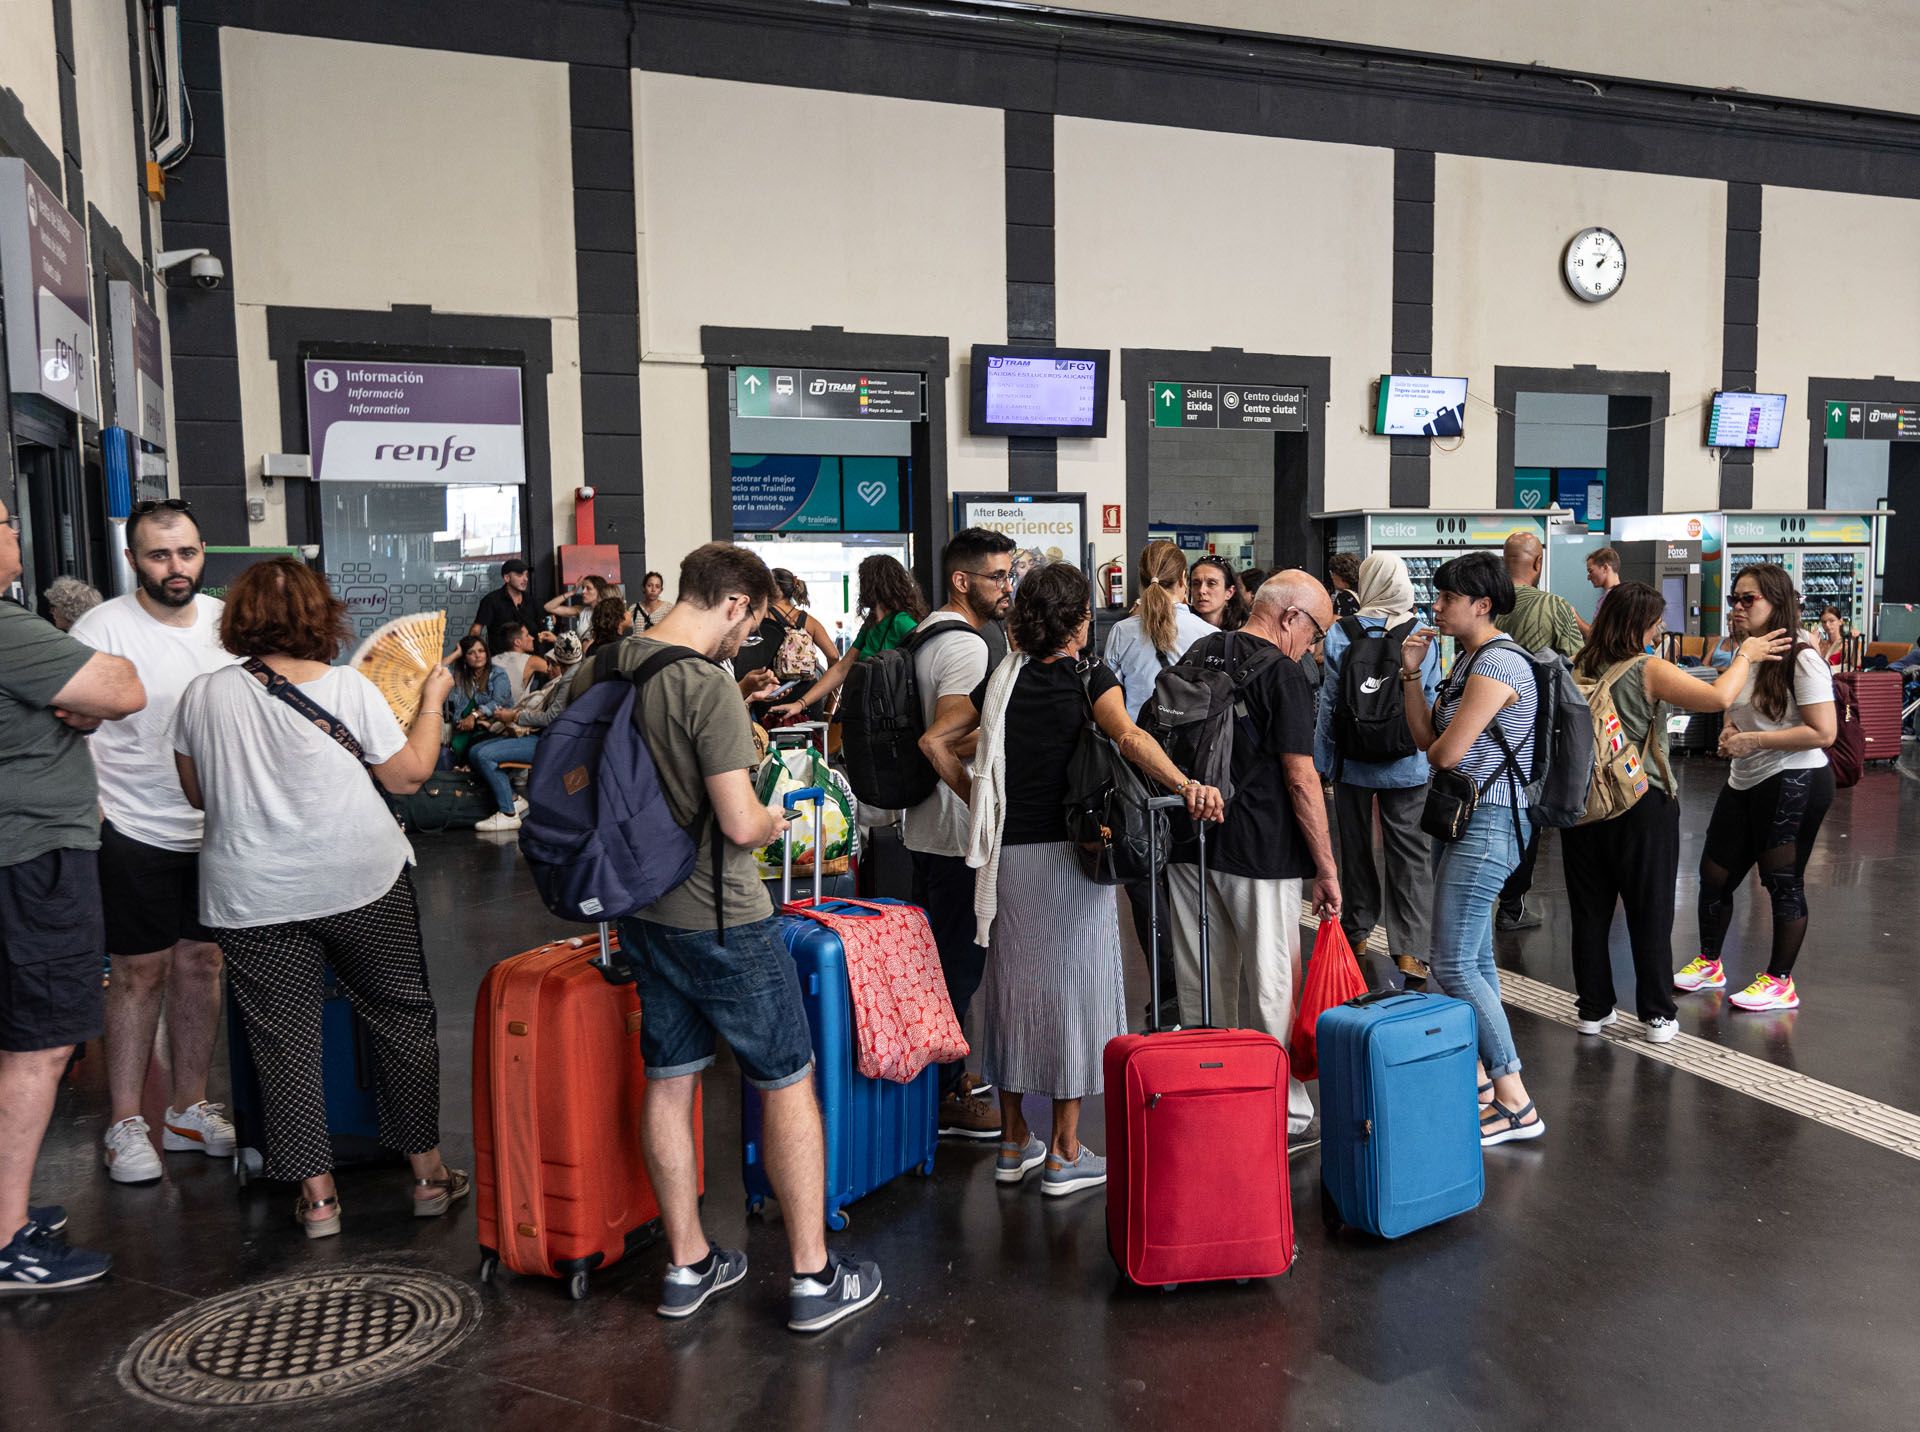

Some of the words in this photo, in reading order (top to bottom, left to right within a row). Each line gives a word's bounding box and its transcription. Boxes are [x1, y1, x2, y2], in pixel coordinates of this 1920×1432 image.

[1595, 237, 1604, 246] 12
[1577, 259, 1584, 267] 9
[1613, 260, 1620, 269] 3
[1595, 282, 1601, 290] 6
[1069, 362, 1094, 371] FGV
[346, 369, 424, 384] Información
[827, 382, 857, 392] TRAM
[348, 387, 404, 399] Informació
[1186, 389, 1213, 398] Salida
[1243, 391, 1269, 401] Centro
[1272, 393, 1299, 403] ciudad
[349, 403, 410, 415] Information
[1186, 402, 1213, 411] Eixida
[1243, 404, 1270, 413] Centre
[1272, 405, 1297, 415] ciutat
[1881, 412, 1897, 420] TRAM
[375, 435, 476, 471] renfe
[763, 475, 770, 483] el
[772, 475, 796, 484] mejor
[762, 484, 796, 492] Trainline
[778, 495, 794, 503] que
[748, 503, 755, 511] la
[757, 503, 786, 511] maleta.
[973, 508, 995, 517] After
[997, 508, 1023, 517] Beach
[808, 515, 838, 524] trainline
[1379, 522, 1417, 537] teika
[1733, 523, 1764, 536] teika
[201, 585, 228, 596] cas
[347, 593, 386, 608] renfe
[843, 1274, 861, 1299] N
